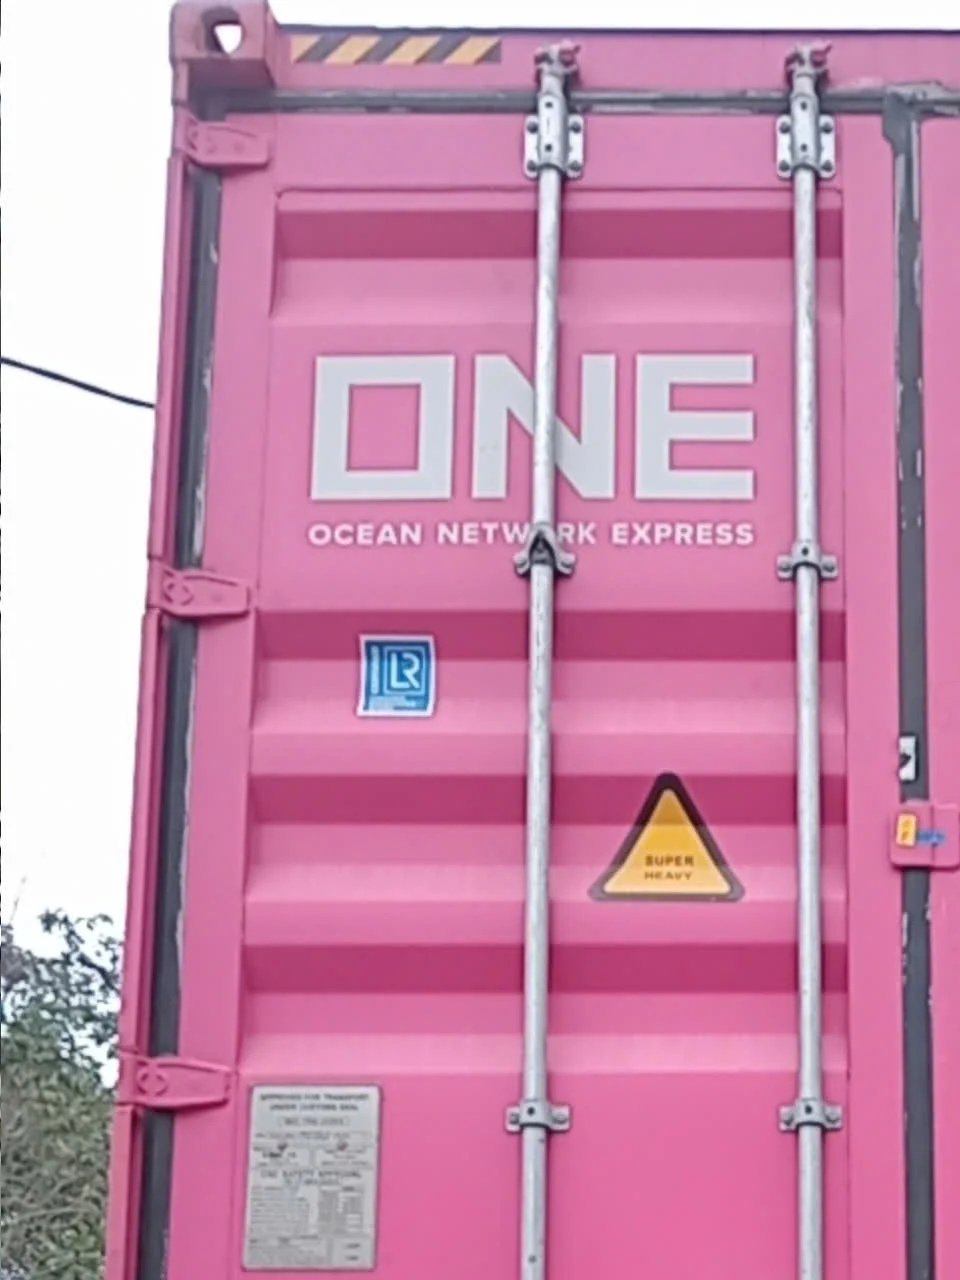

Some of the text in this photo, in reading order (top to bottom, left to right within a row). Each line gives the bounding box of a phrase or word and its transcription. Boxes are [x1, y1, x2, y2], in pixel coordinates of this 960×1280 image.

[310, 354, 754, 499] ONE
[308, 522, 755, 546] OCEAN NETWRK EXPRESS
[645, 855, 695, 867] SUPER
[644, 871, 693, 881] HEAVY
